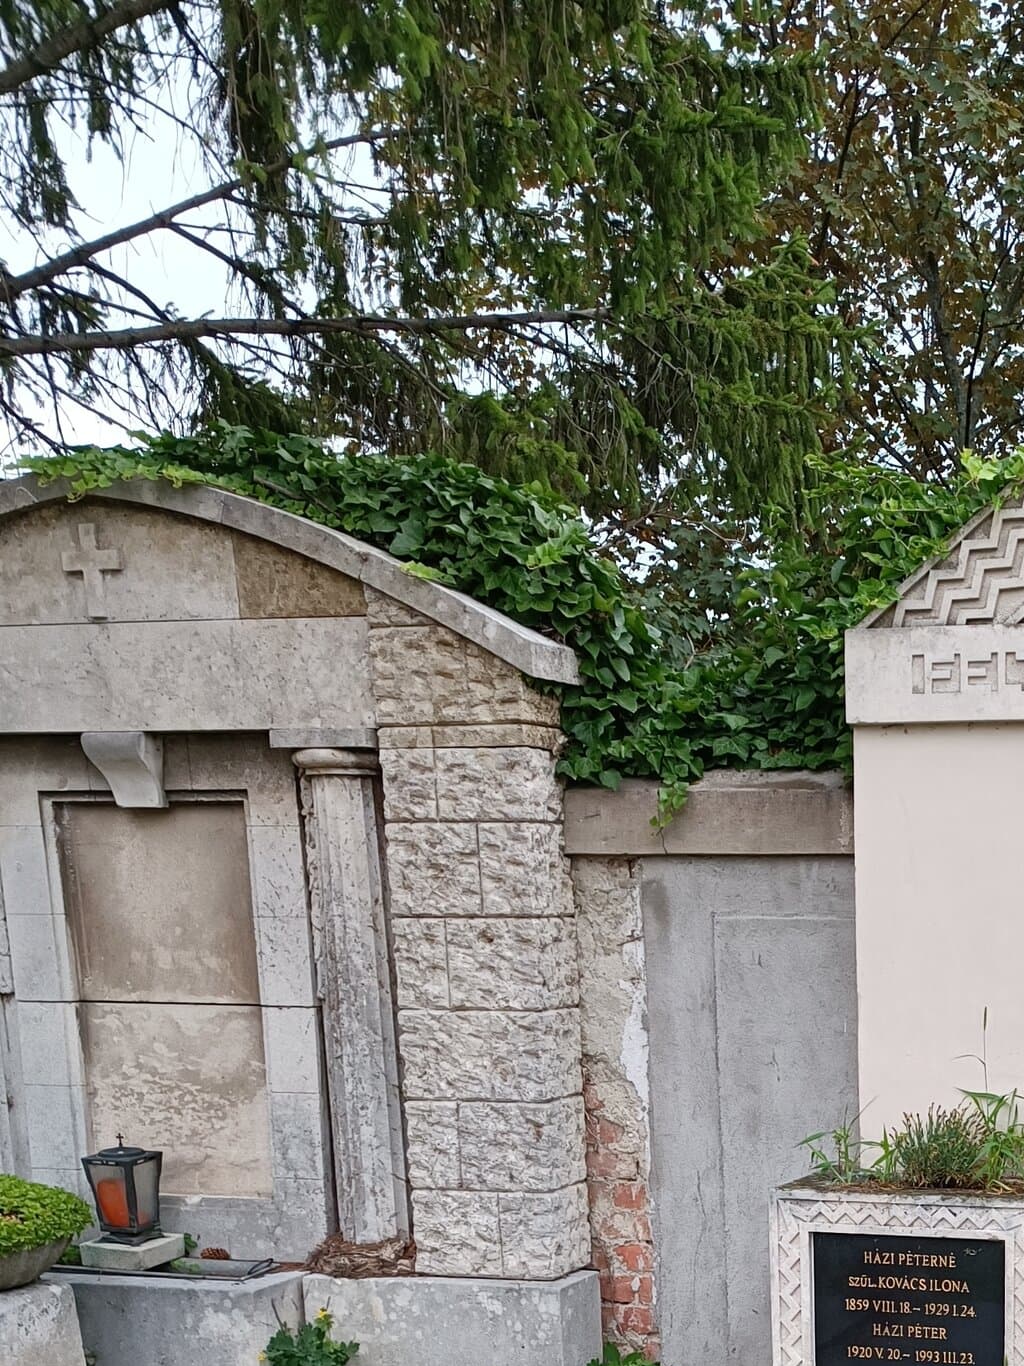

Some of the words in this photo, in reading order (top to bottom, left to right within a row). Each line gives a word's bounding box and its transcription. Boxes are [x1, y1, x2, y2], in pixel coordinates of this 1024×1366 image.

[863, 1248, 895, 1265] HÁZI
[898, 1250, 957, 1268] PÉTERNÉ
[878, 1275, 927, 1291] KOVÁCS
[929, 1279, 970, 1293] ILONA
[844, 1298, 870, 1311] 1859
[872, 1299, 898, 1313] VIII.
[924, 1303, 950, 1316] 1929
[872, 1321, 904, 1337] HÁZI
[907, 1322, 948, 1340] PÉTER
[847, 1345, 873, 1359] 1920
[874, 1347, 884, 1359] V.
[915, 1350, 940, 1363] 1993
